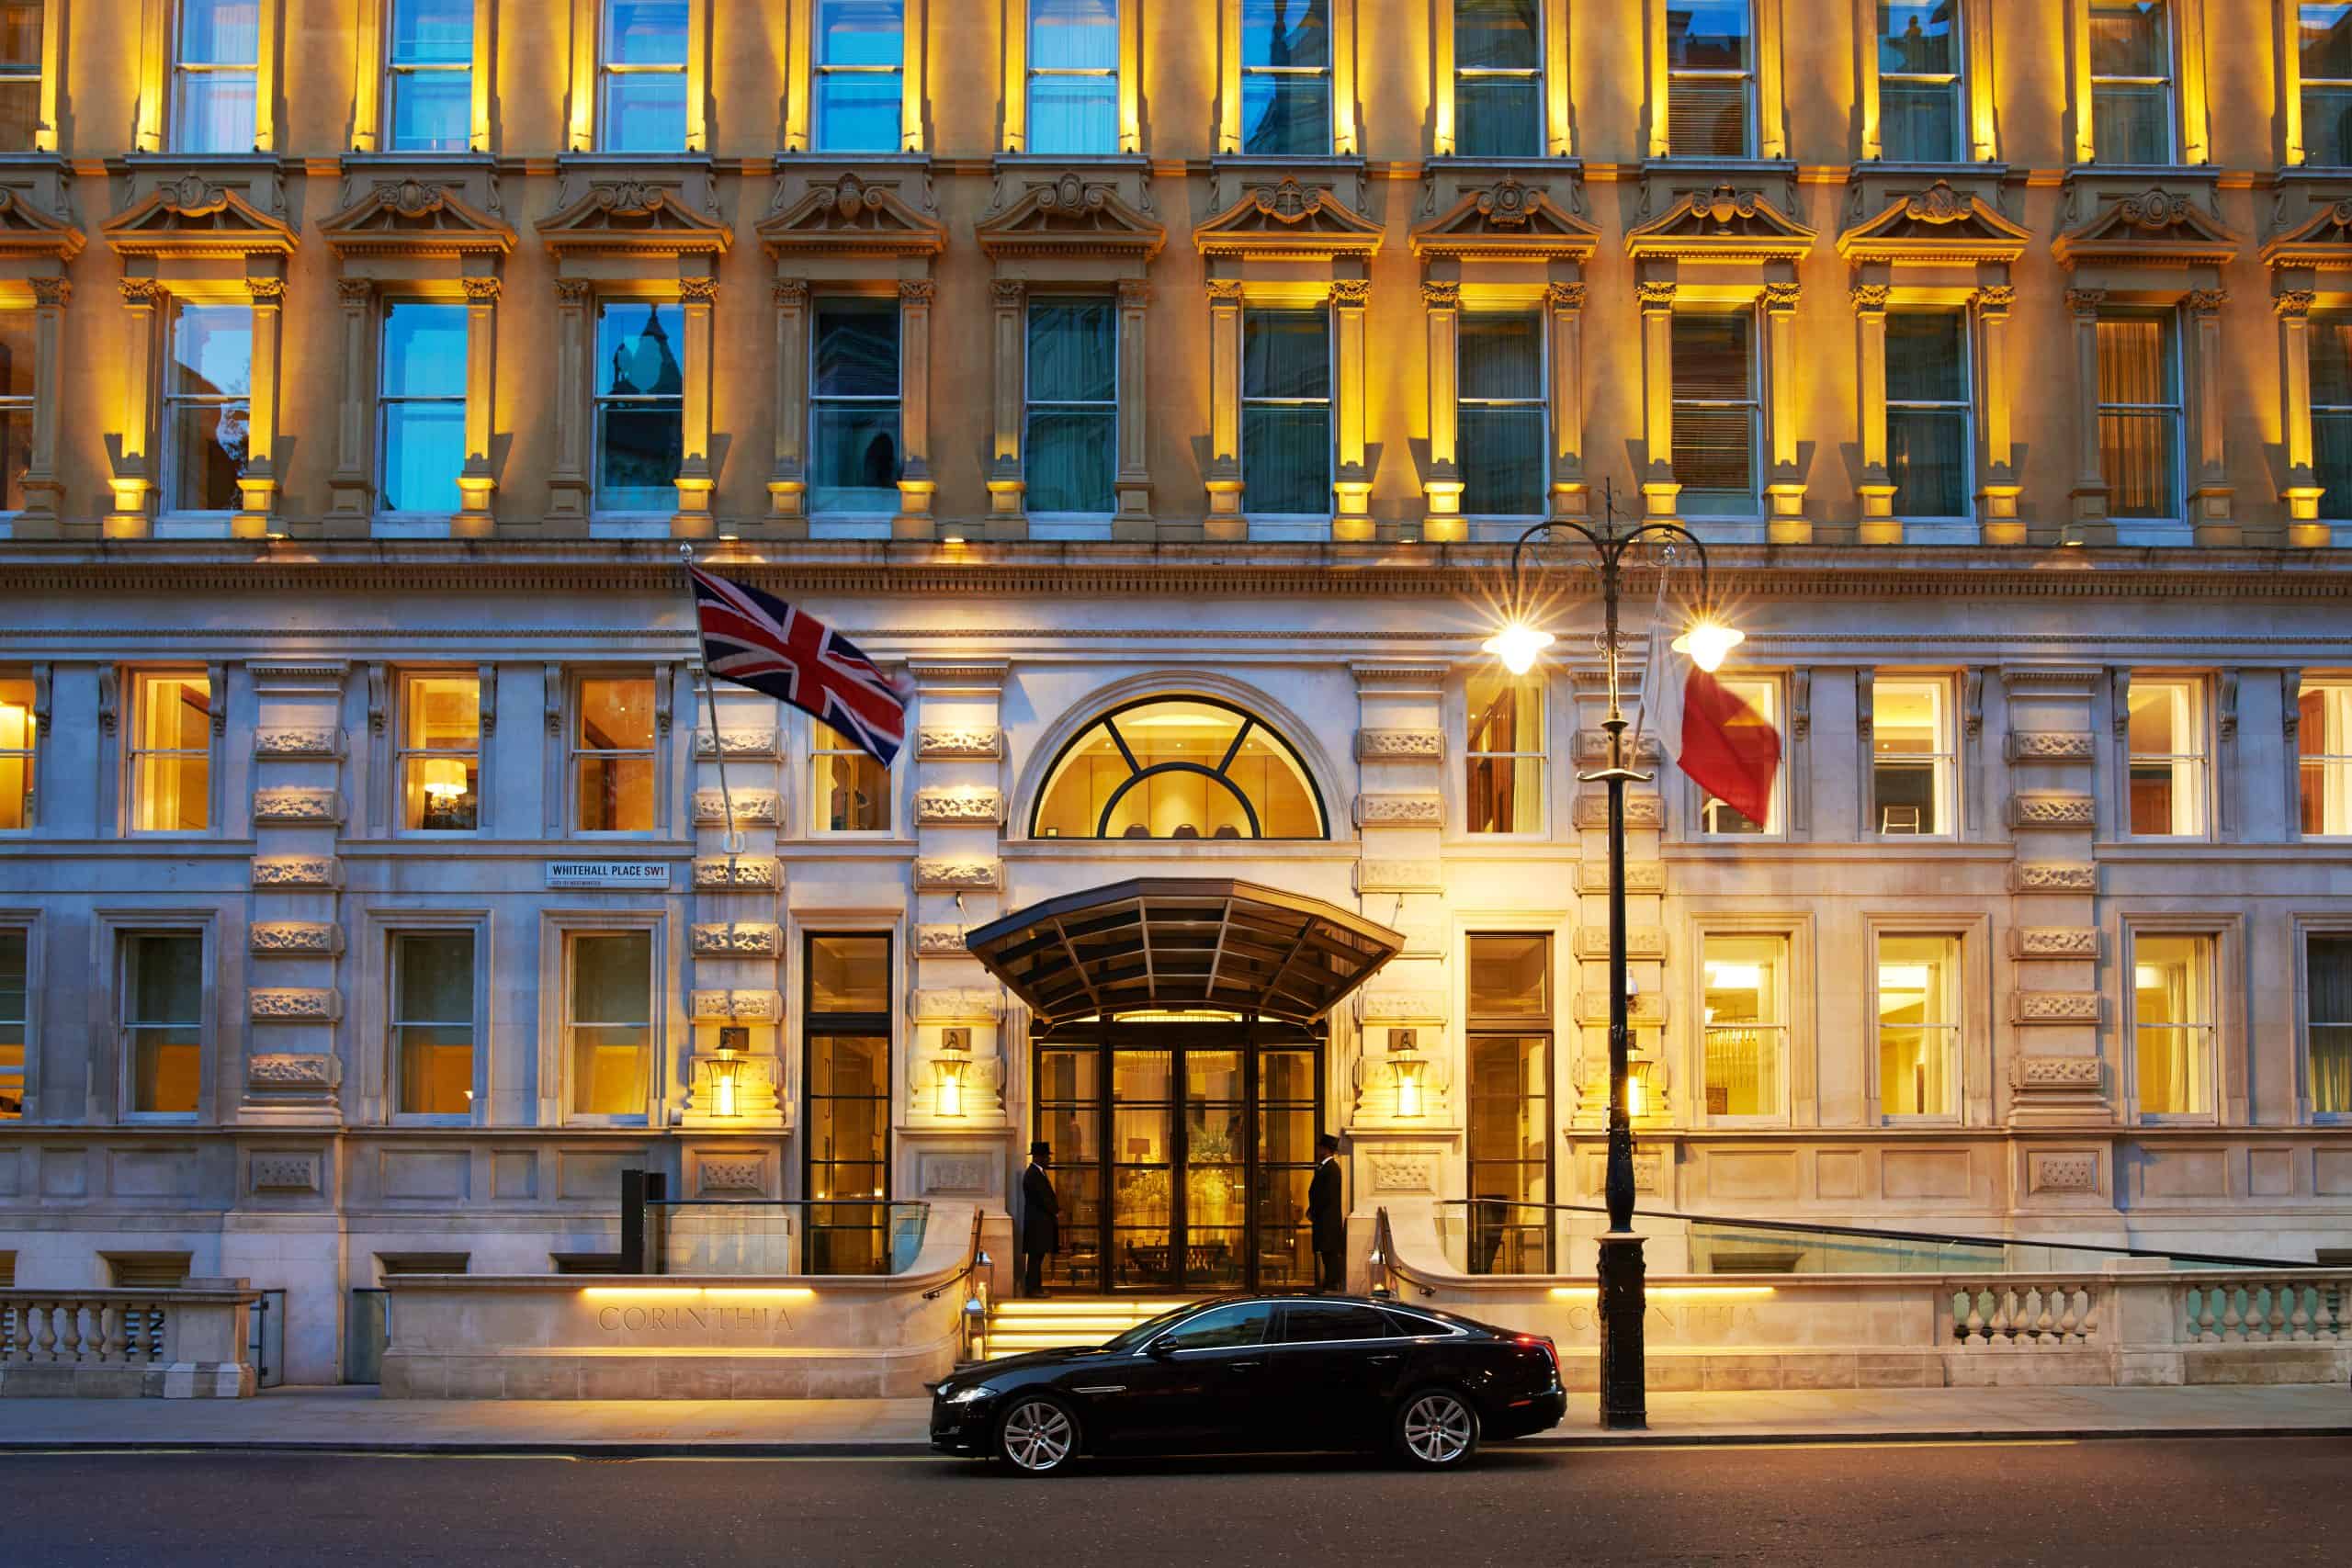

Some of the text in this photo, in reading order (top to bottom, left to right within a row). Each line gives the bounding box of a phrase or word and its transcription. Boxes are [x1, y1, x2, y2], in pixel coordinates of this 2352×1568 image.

[553, 865, 663, 875] WHITEHALL PLACE SW1
[598, 1306, 794, 1331] CORINTHIA
[1567, 1306, 1758, 1331] CNTHIA
